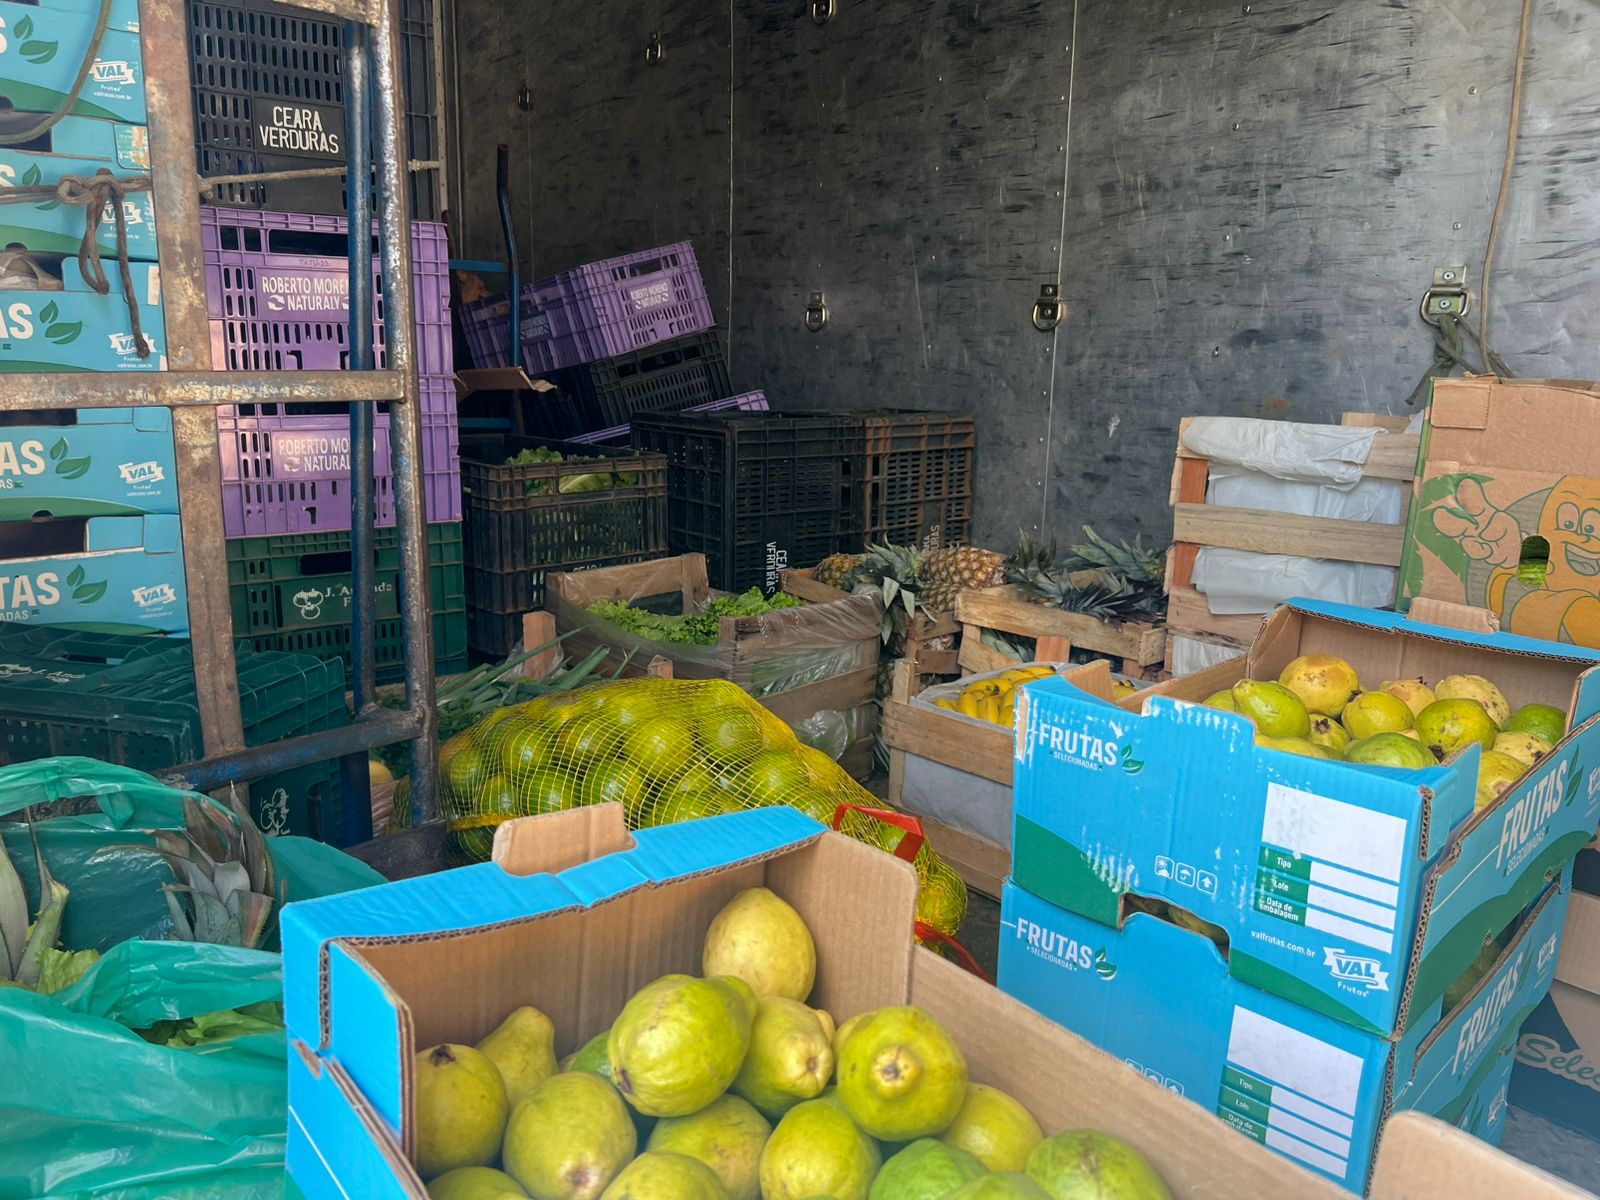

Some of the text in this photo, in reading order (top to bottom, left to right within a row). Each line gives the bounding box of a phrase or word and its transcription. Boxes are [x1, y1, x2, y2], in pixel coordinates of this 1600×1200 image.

[95, 64, 126, 79] VAL
[272, 106, 323, 132] CEARA
[260, 125, 340, 154] VERDURAS
[262, 276, 312, 294] ROBERTO
[287, 294, 340, 311] NATURALY
[279, 438, 328, 455] ROBERTO
[1039, 722, 1118, 766] FRUTAS
[1053, 750, 1099, 771] SELECIONADAS
[1495, 759, 1568, 870] FRUTAS
[1276, 856, 1292, 870] Tipo
[1273, 880, 1290, 892] Lote
[1259, 902, 1300, 922] embalagem
[1266, 896, 1293, 912] Data de
[1016, 917, 1093, 970] FRUTAS
[1250, 929, 1317, 958] valfrutas.com.br
[1334, 958, 1377, 979] VAL
[1452, 951, 1524, 1077] FRUTAS
